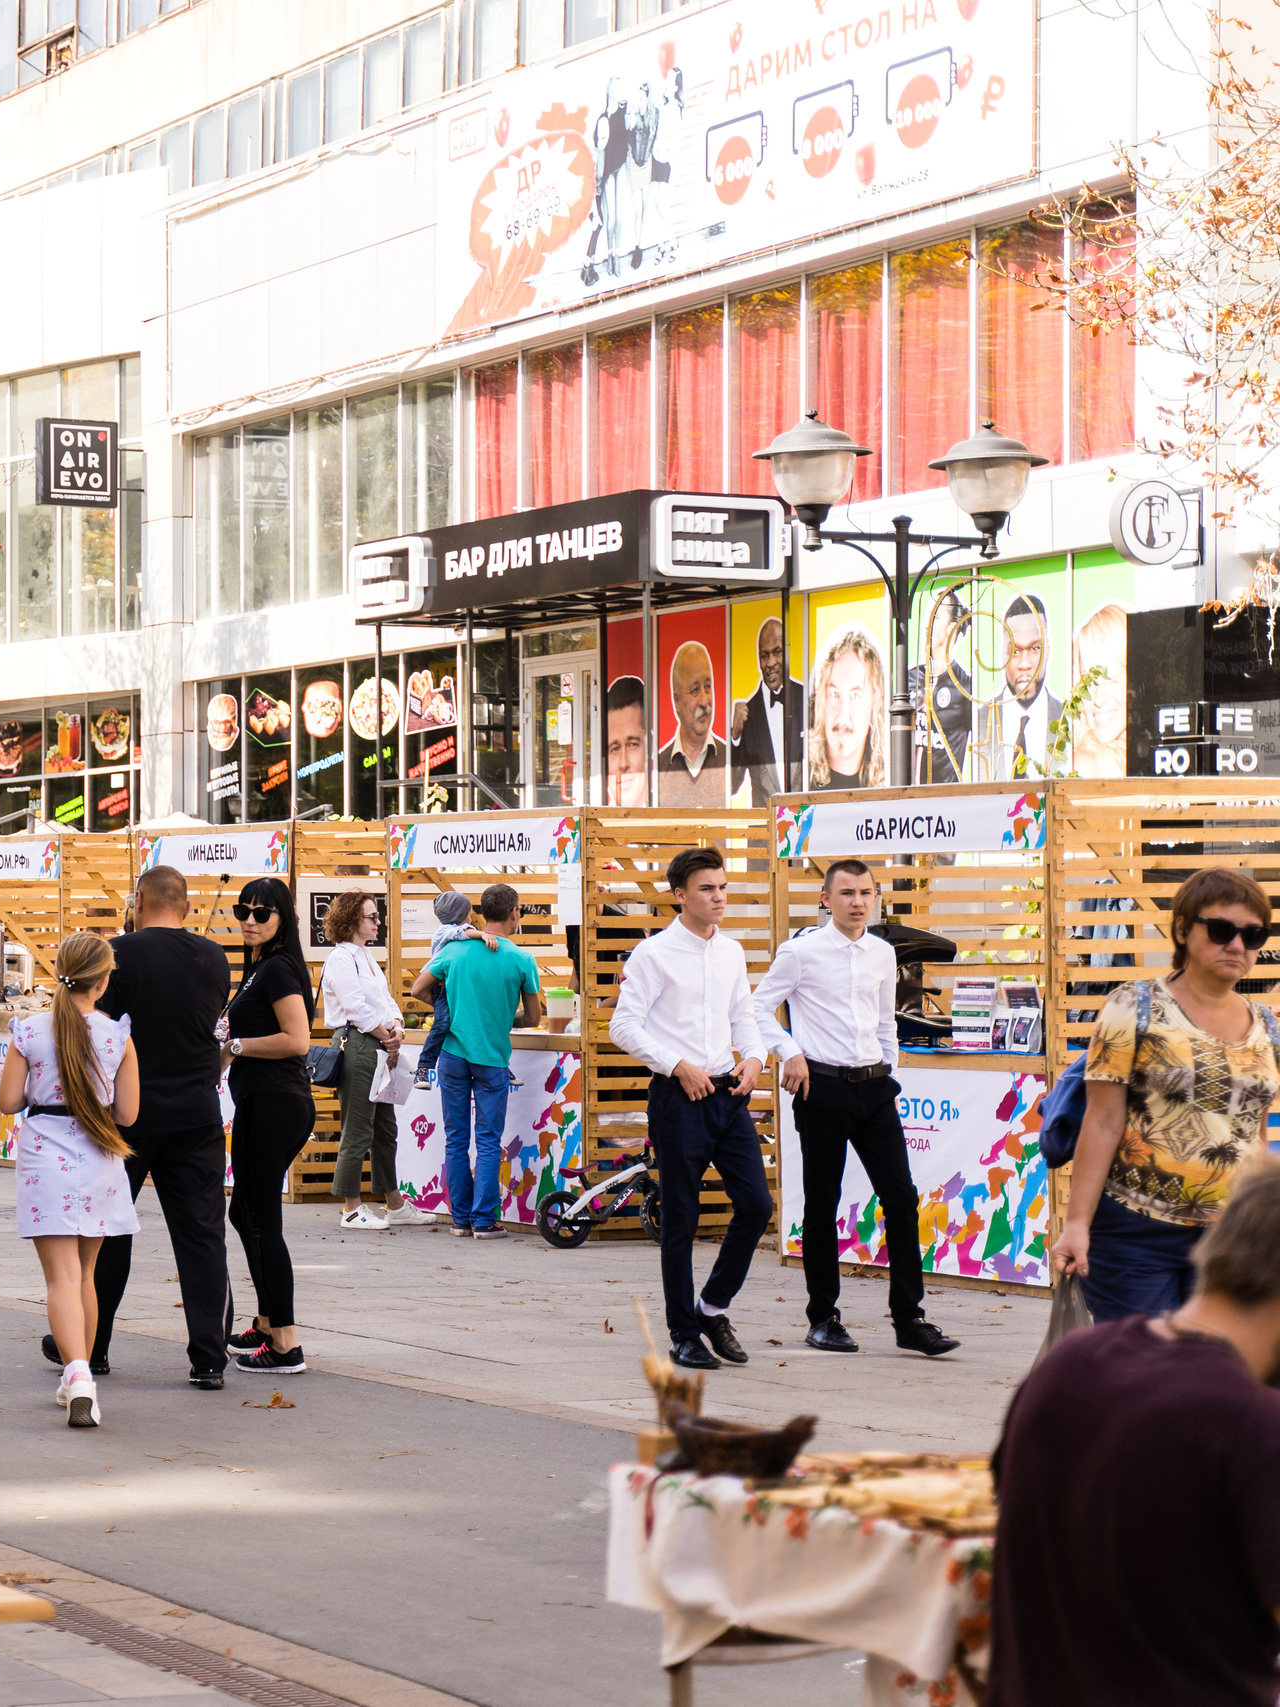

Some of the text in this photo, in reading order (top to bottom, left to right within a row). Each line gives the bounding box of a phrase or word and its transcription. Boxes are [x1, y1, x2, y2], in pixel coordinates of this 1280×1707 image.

[725, 0, 938, 102] ДАРИМ СТОЛ НА
[896, 98, 942, 129] 10 000
[814, 128, 844, 156] 000
[517, 159, 542, 199] ДР
[725, 156, 754, 182] 000
[511, 183, 558, 217] ПОДАРОК
[505, 195, 561, 240] 68-69-69
[60, 430, 92, 448] ON
[60, 450, 100, 469] AIR
[60, 470, 104, 489] EVO
[444, 547, 487, 581] БАР
[487, 535, 533, 578] ДЛЯ
[538, 520, 624, 565] ТАНЦЕВ
[1158, 706, 1191, 734] FE
[1215, 707, 1254, 732] FE
[408, 747, 456, 779] КАЧЕТВЕННО
[1154, 748, 1191, 774] RO
[1215, 748, 1259, 772] RO
[855, 816, 956, 841] «БАРИСТА»
[187, 842, 238, 864] «ИНДЕЕЦ»
[433, 831, 532, 855] «СМУЗИШНАЯ»
[939, 1099, 960, 1121] Я»
[414, 1121, 429, 1135] 429
[905, 1137, 931, 1152] РОДА
